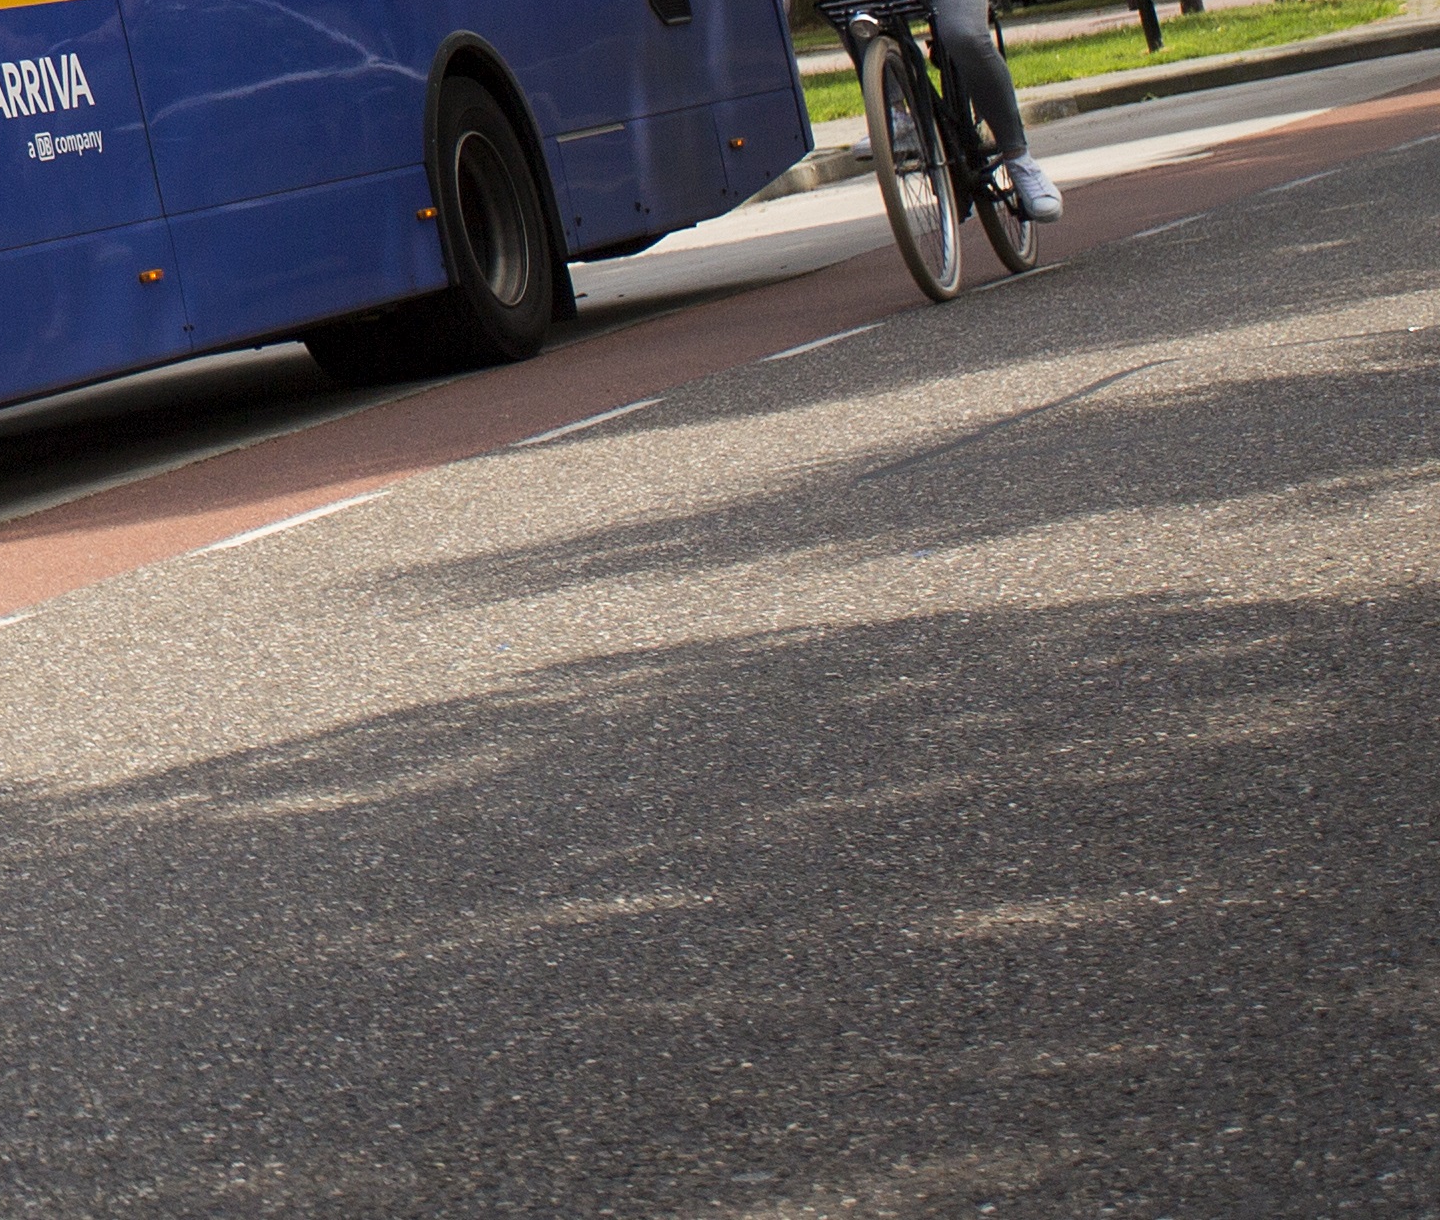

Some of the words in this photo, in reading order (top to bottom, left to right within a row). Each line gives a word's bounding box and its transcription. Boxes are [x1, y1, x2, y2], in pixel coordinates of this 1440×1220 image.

[28, 141, 37, 158] a
[36, 133, 54, 159] DB
[55, 130, 103, 156] company
